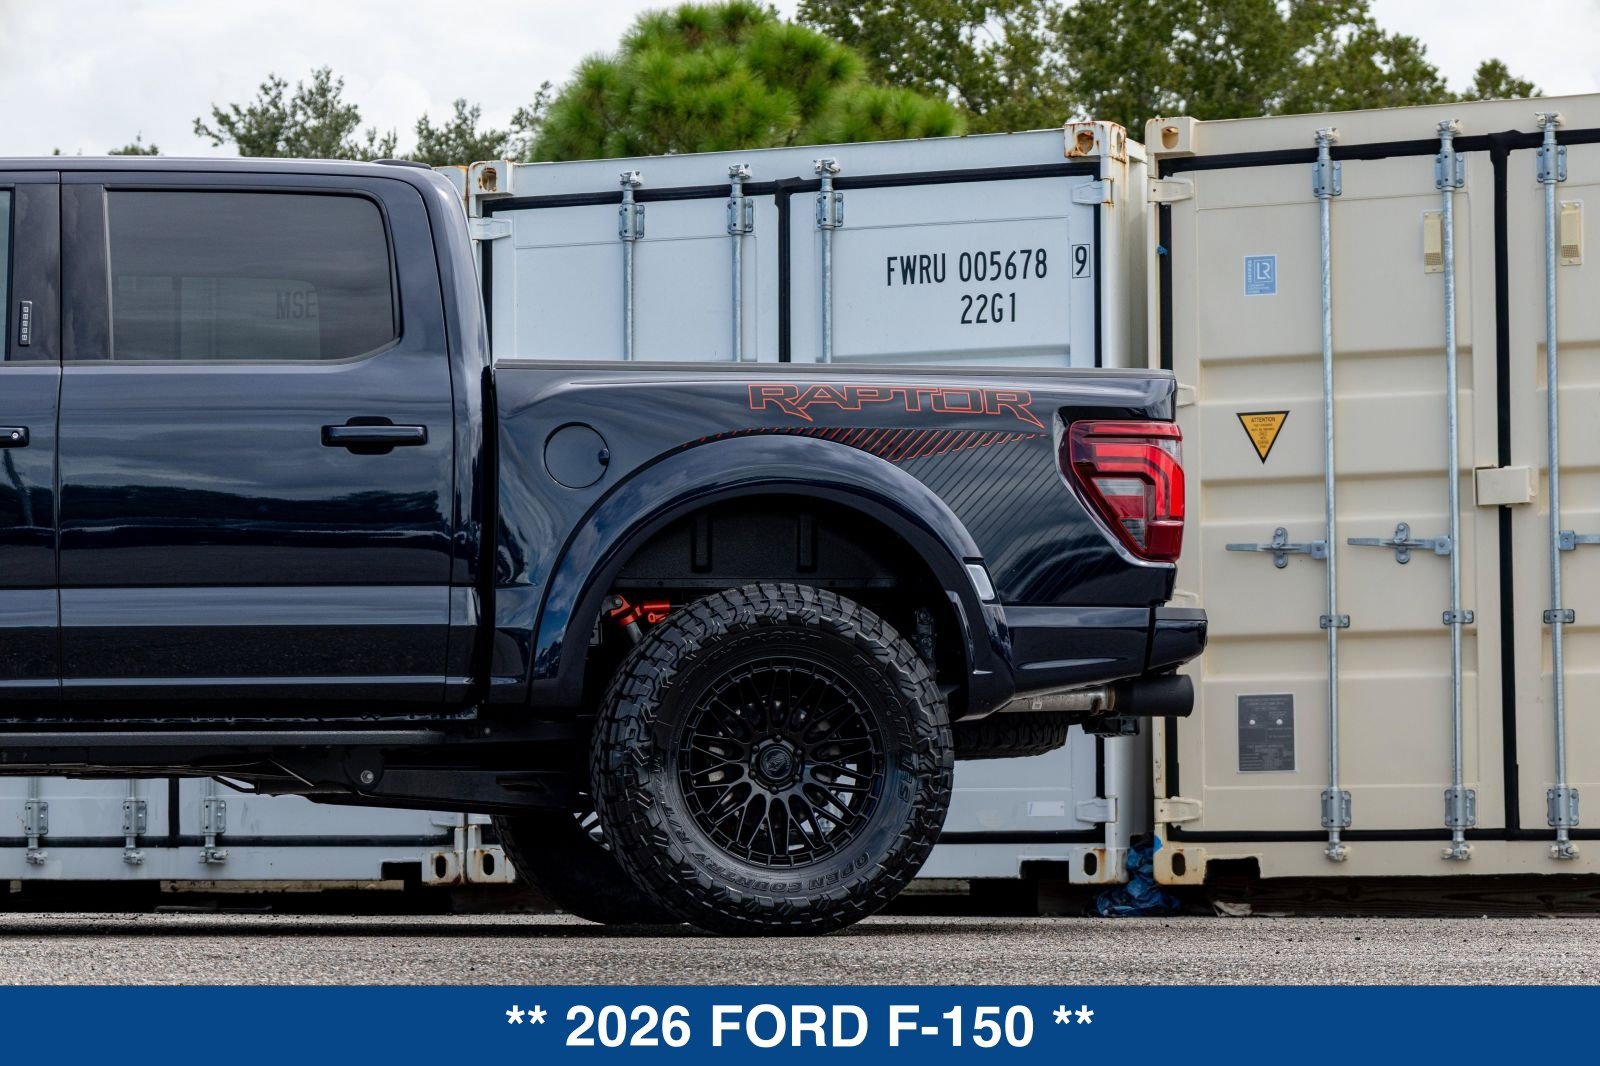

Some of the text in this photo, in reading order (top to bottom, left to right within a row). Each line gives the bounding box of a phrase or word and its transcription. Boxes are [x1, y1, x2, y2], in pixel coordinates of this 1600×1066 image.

[887, 245, 1087, 286] FWRU 005678 9
[1256, 262, 1272, 280] LR
[961, 292, 1016, 324] 22G1
[747, 384, 1045, 429] RAPTOR
[691, 851, 803, 894] COUNTRY
[808, 852, 871, 891] OPEN
